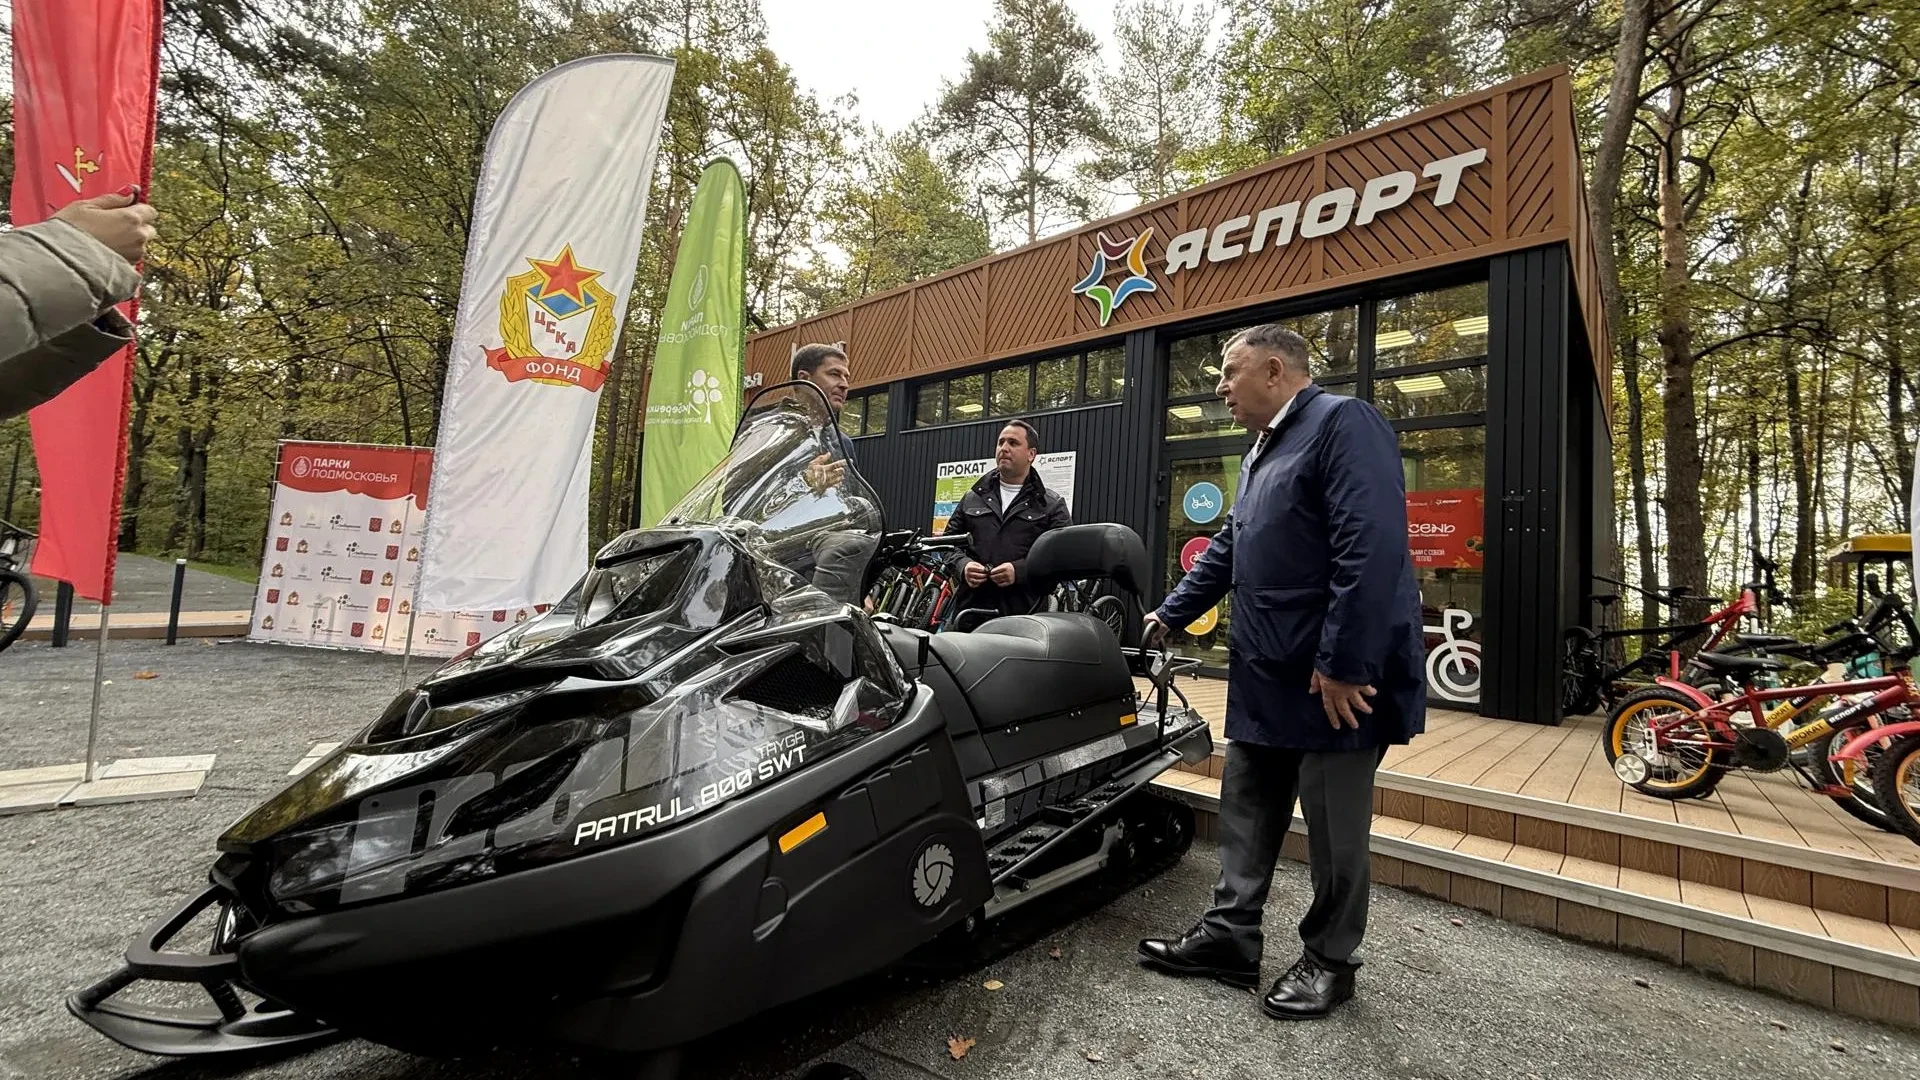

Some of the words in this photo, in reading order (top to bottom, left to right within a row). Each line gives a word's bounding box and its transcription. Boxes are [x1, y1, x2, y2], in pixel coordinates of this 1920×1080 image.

[1165, 147, 1487, 275] ЯСПОРТ
[534, 310, 576, 353] ЦСКА
[525, 361, 582, 380] ФОНД
[311, 468, 398, 483] ПОДМОСКОВЬЯ
[313, 458, 351, 469] ПАРКИ
[939, 462, 987, 477] ПРОКАТ
[755, 730, 805, 759] TAYGA
[573, 796, 695, 846] PATRUL
[700, 768, 753, 806] 800
[757, 744, 807, 781] SWT
